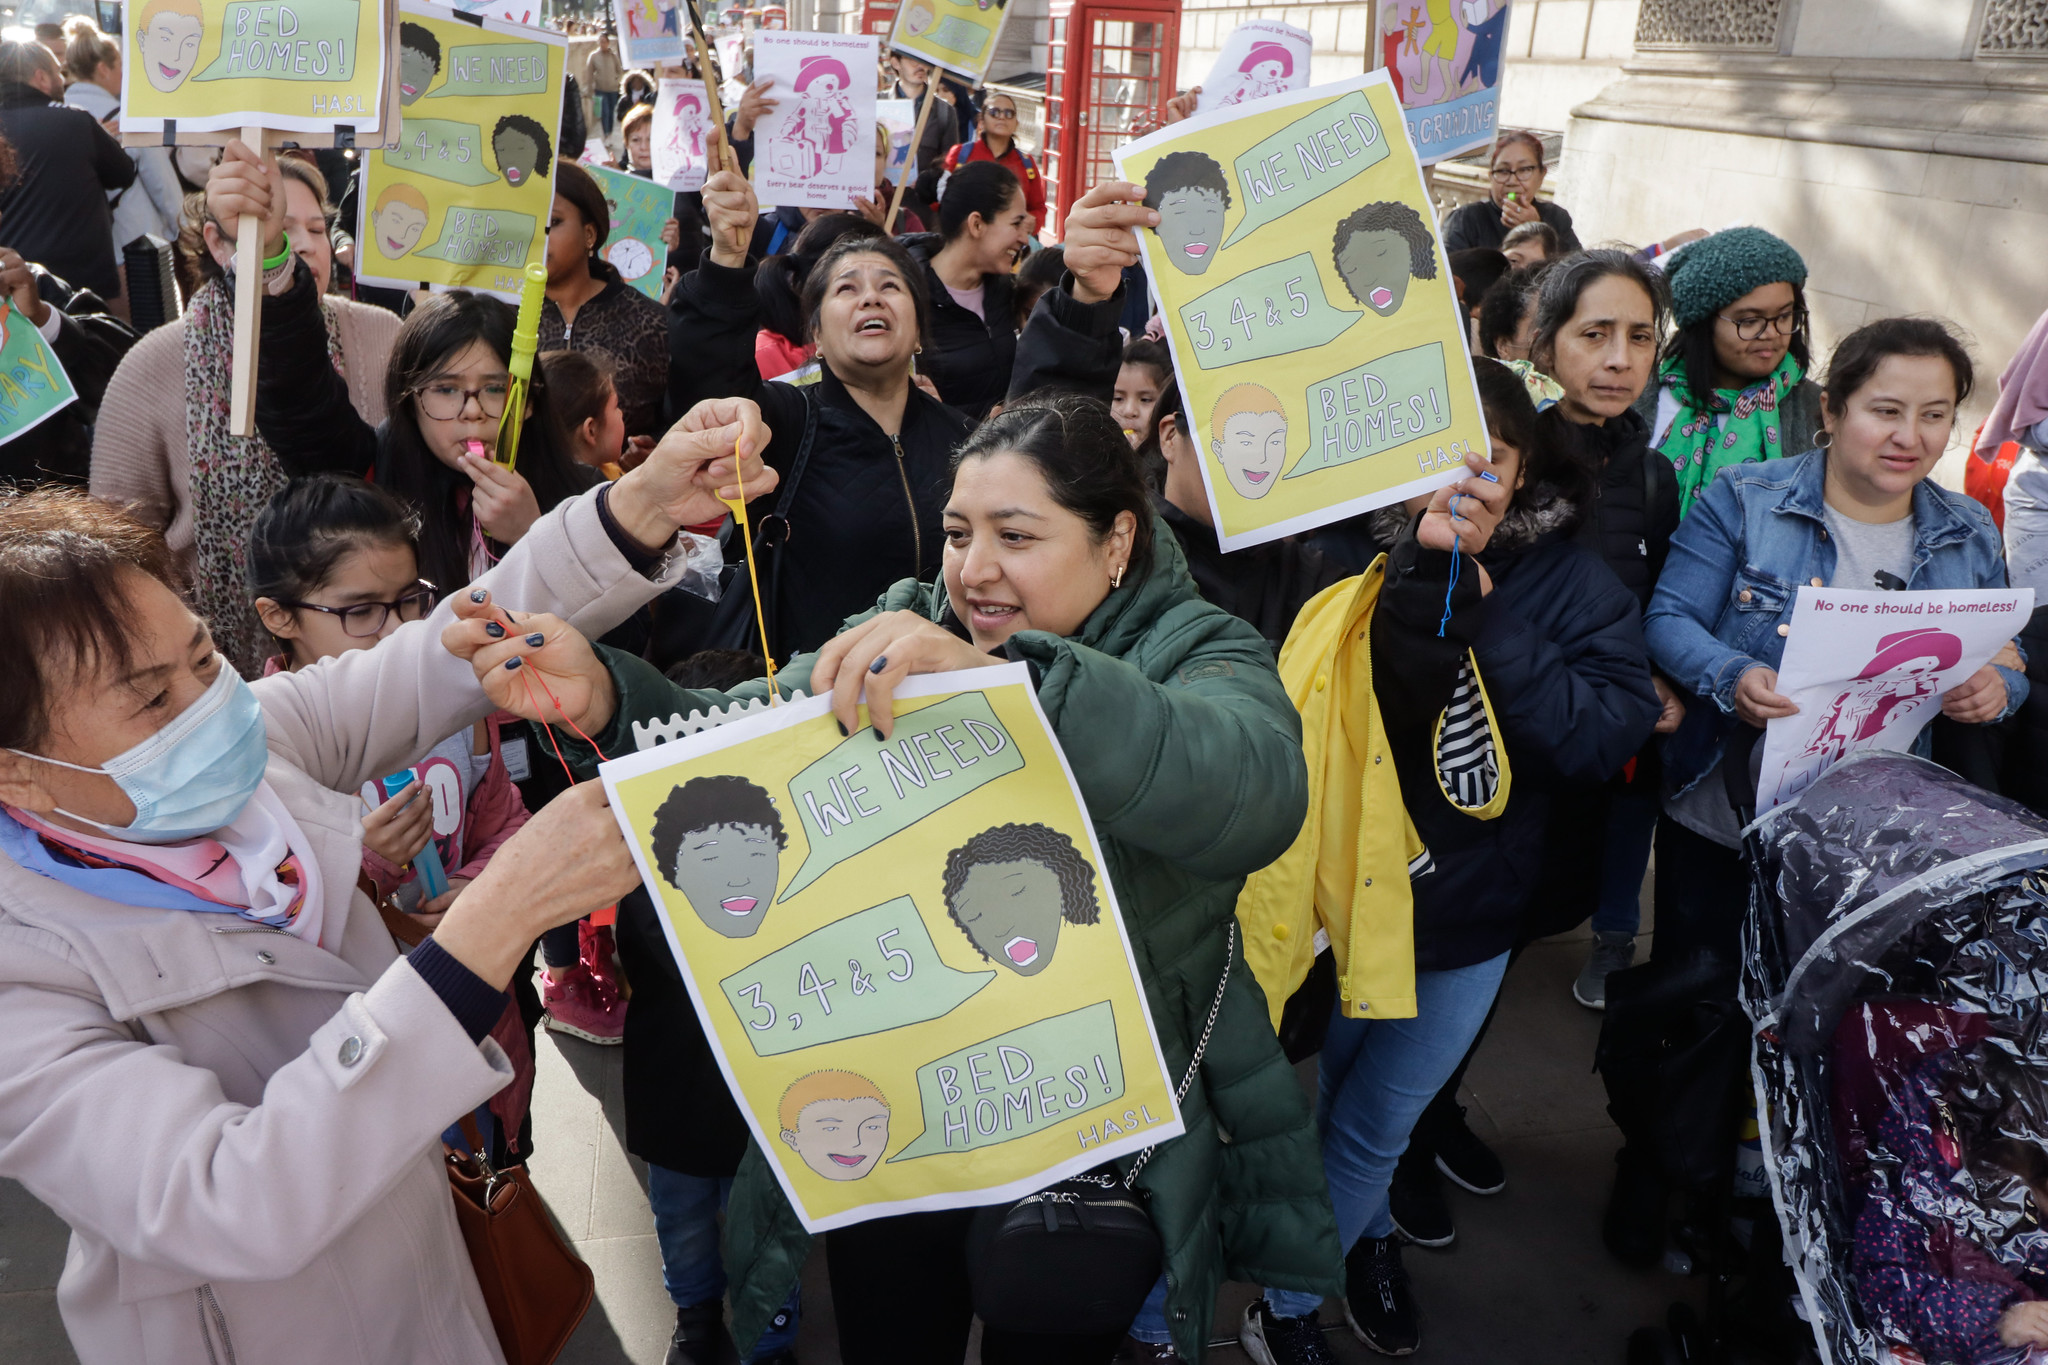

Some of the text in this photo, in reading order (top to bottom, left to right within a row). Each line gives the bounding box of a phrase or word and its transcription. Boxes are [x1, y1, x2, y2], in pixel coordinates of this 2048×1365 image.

[235, 5, 299, 37] BED
[226, 38, 345, 76] HOMES!
[763, 36, 773, 44] No
[793, 38, 818, 46] should
[821, 39, 829, 47] be
[832, 40, 869, 49] homeless!
[453, 56, 545, 84] WE NEED
[312, 94, 367, 115] HASL
[456, 136, 471, 163] 5
[1243, 112, 1379, 204] WE NEED
[767, 180, 786, 189] Every
[789, 181, 804, 189] bear
[807, 182, 839, 191] deserves
[848, 185, 867, 193] good
[806, 192, 827, 200] home
[454, 211, 499, 238] BED
[443, 235, 523, 263] HOMES!
[494, 275, 525, 294] HAS
[1264, 296, 1283, 327] &
[1284, 276, 1310, 318] 5
[1320, 373, 1388, 422] BED
[1323, 387, 1442, 462] HOMES!
[1815, 599, 2018, 615] No one should be homeless!
[803, 718, 1007, 837] WE NEED
[849, 959, 878, 996] &
[876, 927, 914, 983] 5
[936, 1045, 1035, 1106] BED
[943, 1055, 1112, 1147] HOMES!
[1076, 1105, 1161, 1149] HASL
